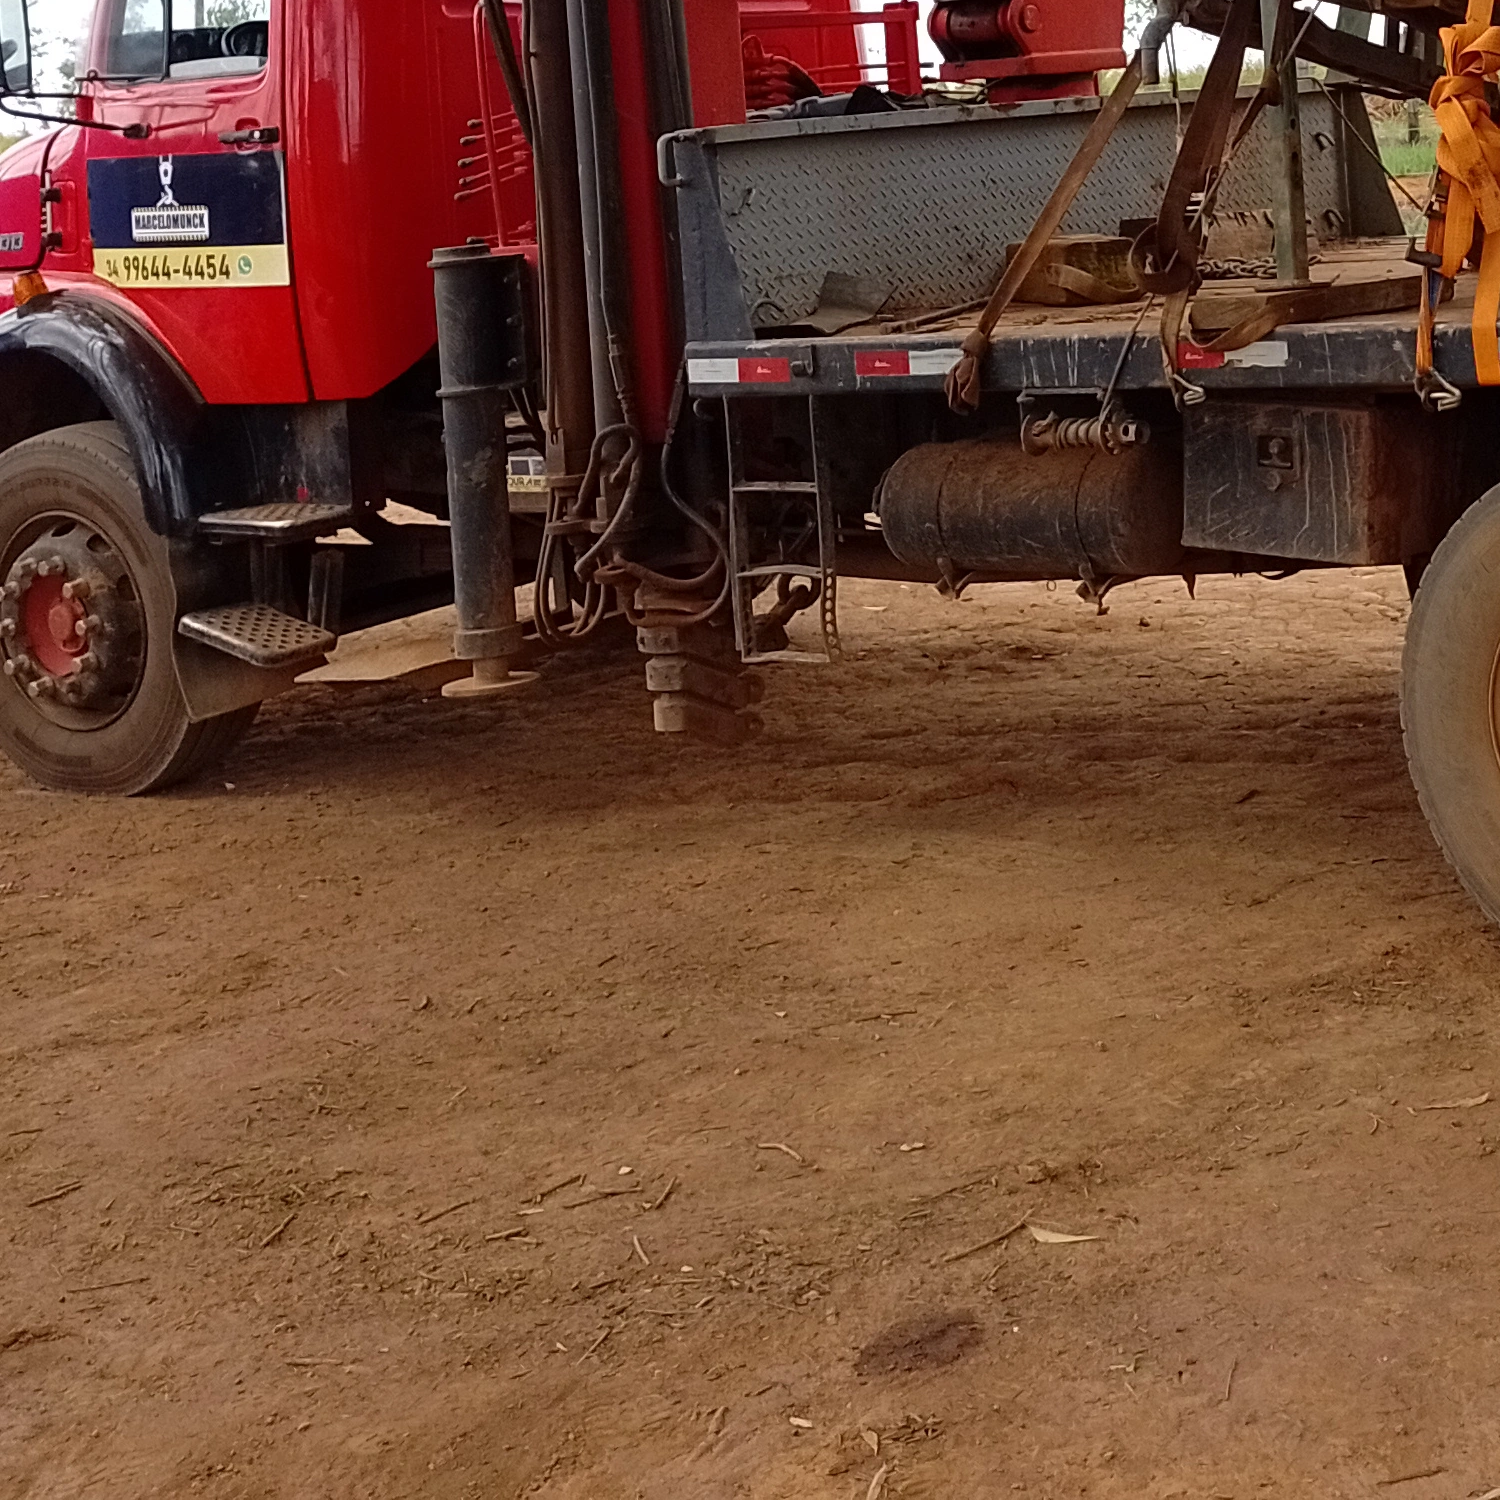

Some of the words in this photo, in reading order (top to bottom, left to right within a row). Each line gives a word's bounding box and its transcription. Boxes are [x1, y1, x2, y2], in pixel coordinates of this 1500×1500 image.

[133, 212, 206, 231] MARCELOMUNCK
[105, 258, 119, 278] 34
[122, 253, 231, 282] 99644-4454
